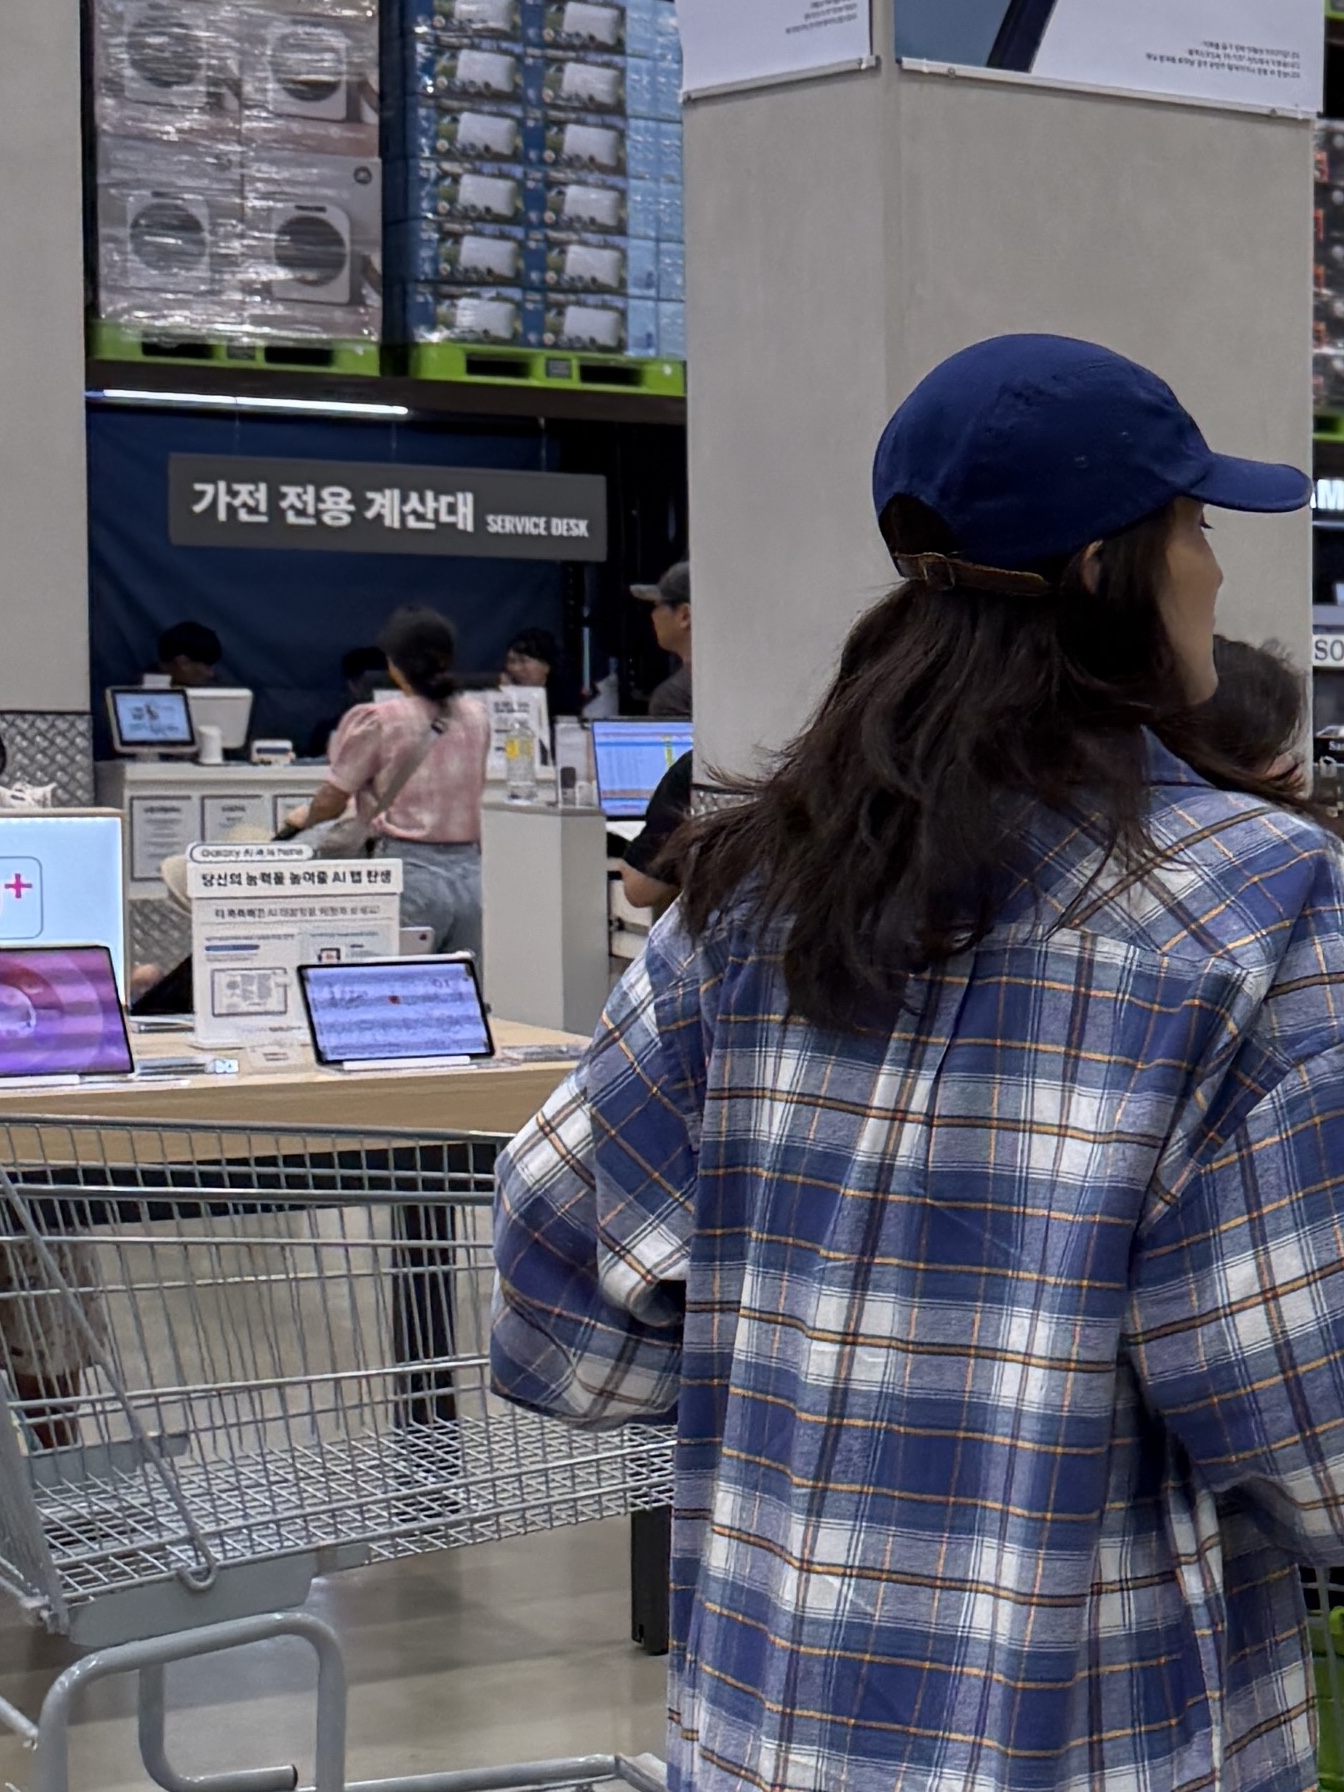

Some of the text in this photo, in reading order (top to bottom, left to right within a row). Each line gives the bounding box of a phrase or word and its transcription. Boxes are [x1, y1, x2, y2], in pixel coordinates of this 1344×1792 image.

[192, 480, 590, 538] 가전 전용 계산대 SERVICE DESK
[201, 872, 243, 888] 당신의
[331, 871, 346, 884] AI
